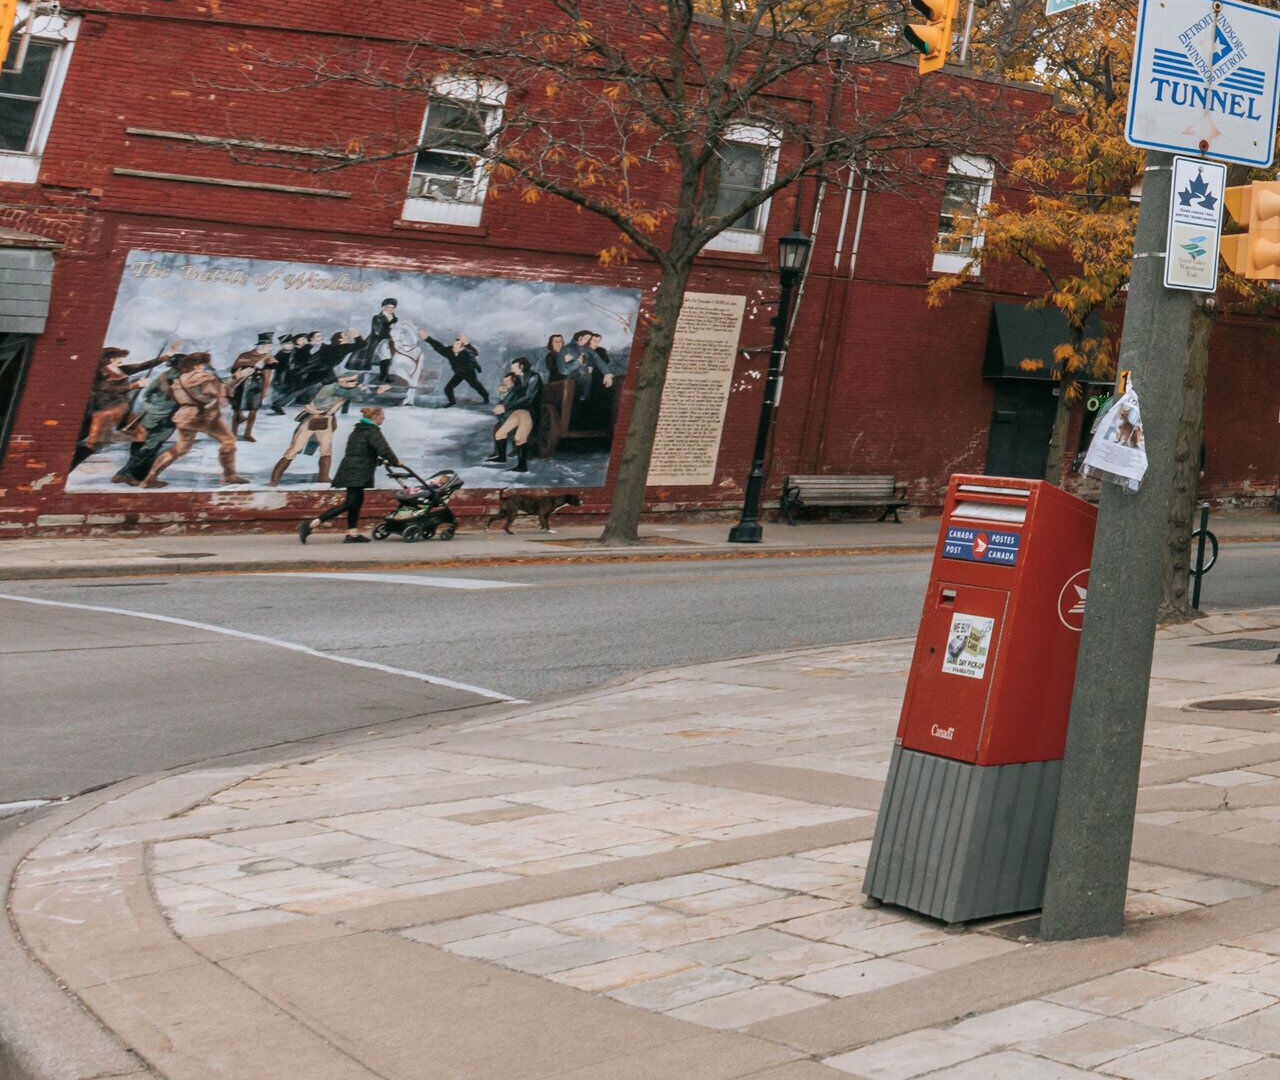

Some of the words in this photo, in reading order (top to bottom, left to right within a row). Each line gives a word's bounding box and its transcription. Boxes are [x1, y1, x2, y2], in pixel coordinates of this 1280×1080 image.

[1178, 12, 1213, 44] DETROIT
[1217, 13, 1243, 52] INDSOR
[1184, 41, 1216, 85] WINDSOR
[1213, 47, 1248, 79] DETROIT
[1151, 77, 1261, 121] TUNNEL
[129, 261, 168, 279] The
[180, 264, 248, 286] Battle
[255, 269, 283, 292] of
[283, 271, 373, 293] Windsor
[946, 545, 962, 554] POST
[949, 530, 974, 540] CANADA
[991, 535, 1015, 545] POSTES
[988, 550, 1014, 561] CANADA
[931, 724, 954, 740] Canada
